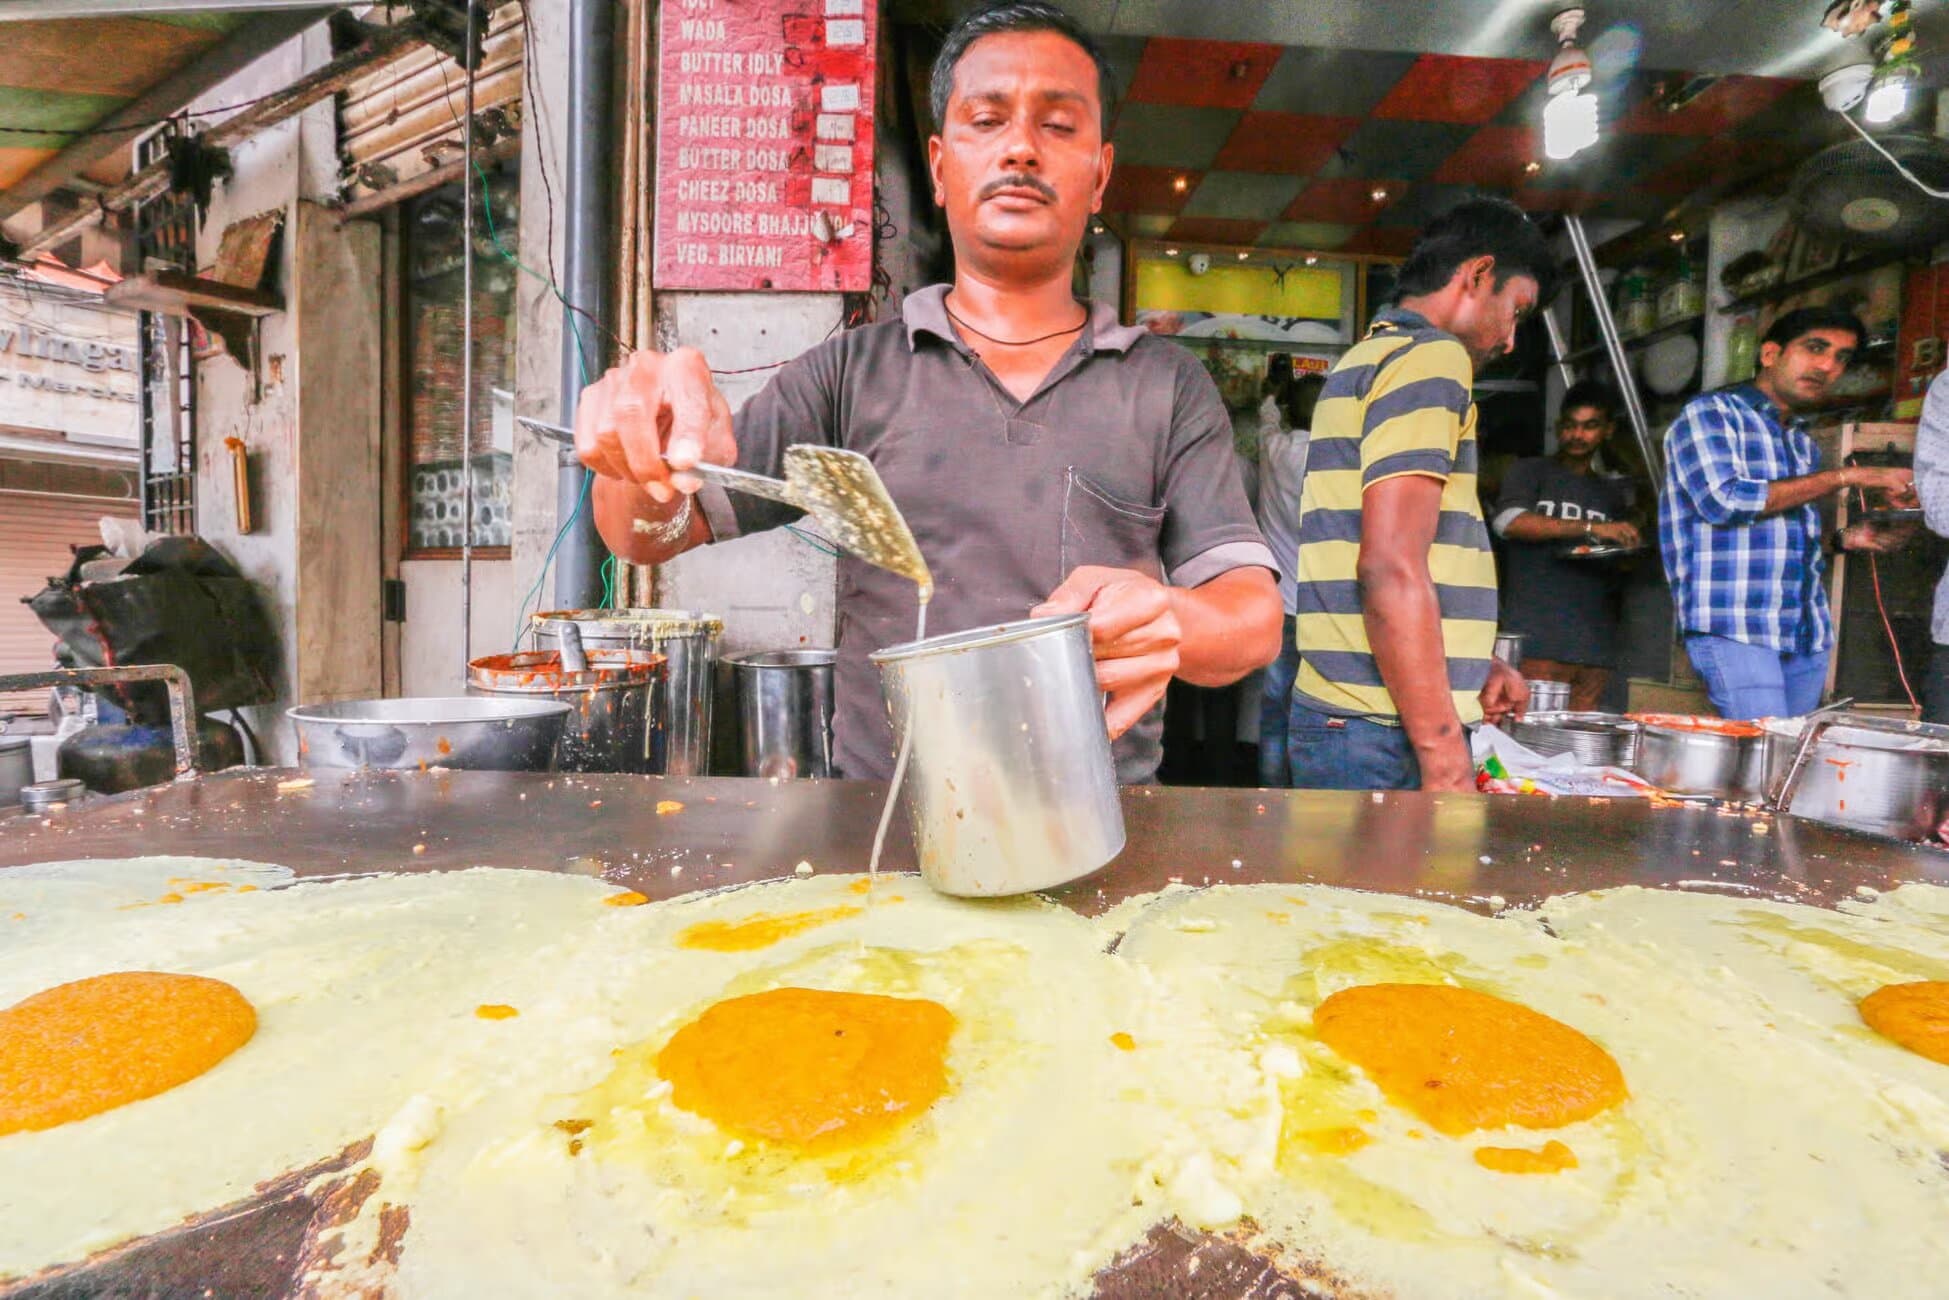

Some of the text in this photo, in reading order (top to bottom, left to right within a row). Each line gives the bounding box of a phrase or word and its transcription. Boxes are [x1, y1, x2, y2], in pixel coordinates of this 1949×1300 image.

[680, 19, 726, 41] WADA
[681, 52, 784, 76] BUTTER IDLY
[680, 83, 792, 107] MASALA DOSA
[679, 115, 789, 139] PANEER DOSA
[678, 147, 789, 172] BUTTER DOSA
[678, 180, 778, 203] CHEEZ DOSA
[677, 210, 753, 234] MYSOORE
[677, 243, 783, 268] VEG. BIRYANI
